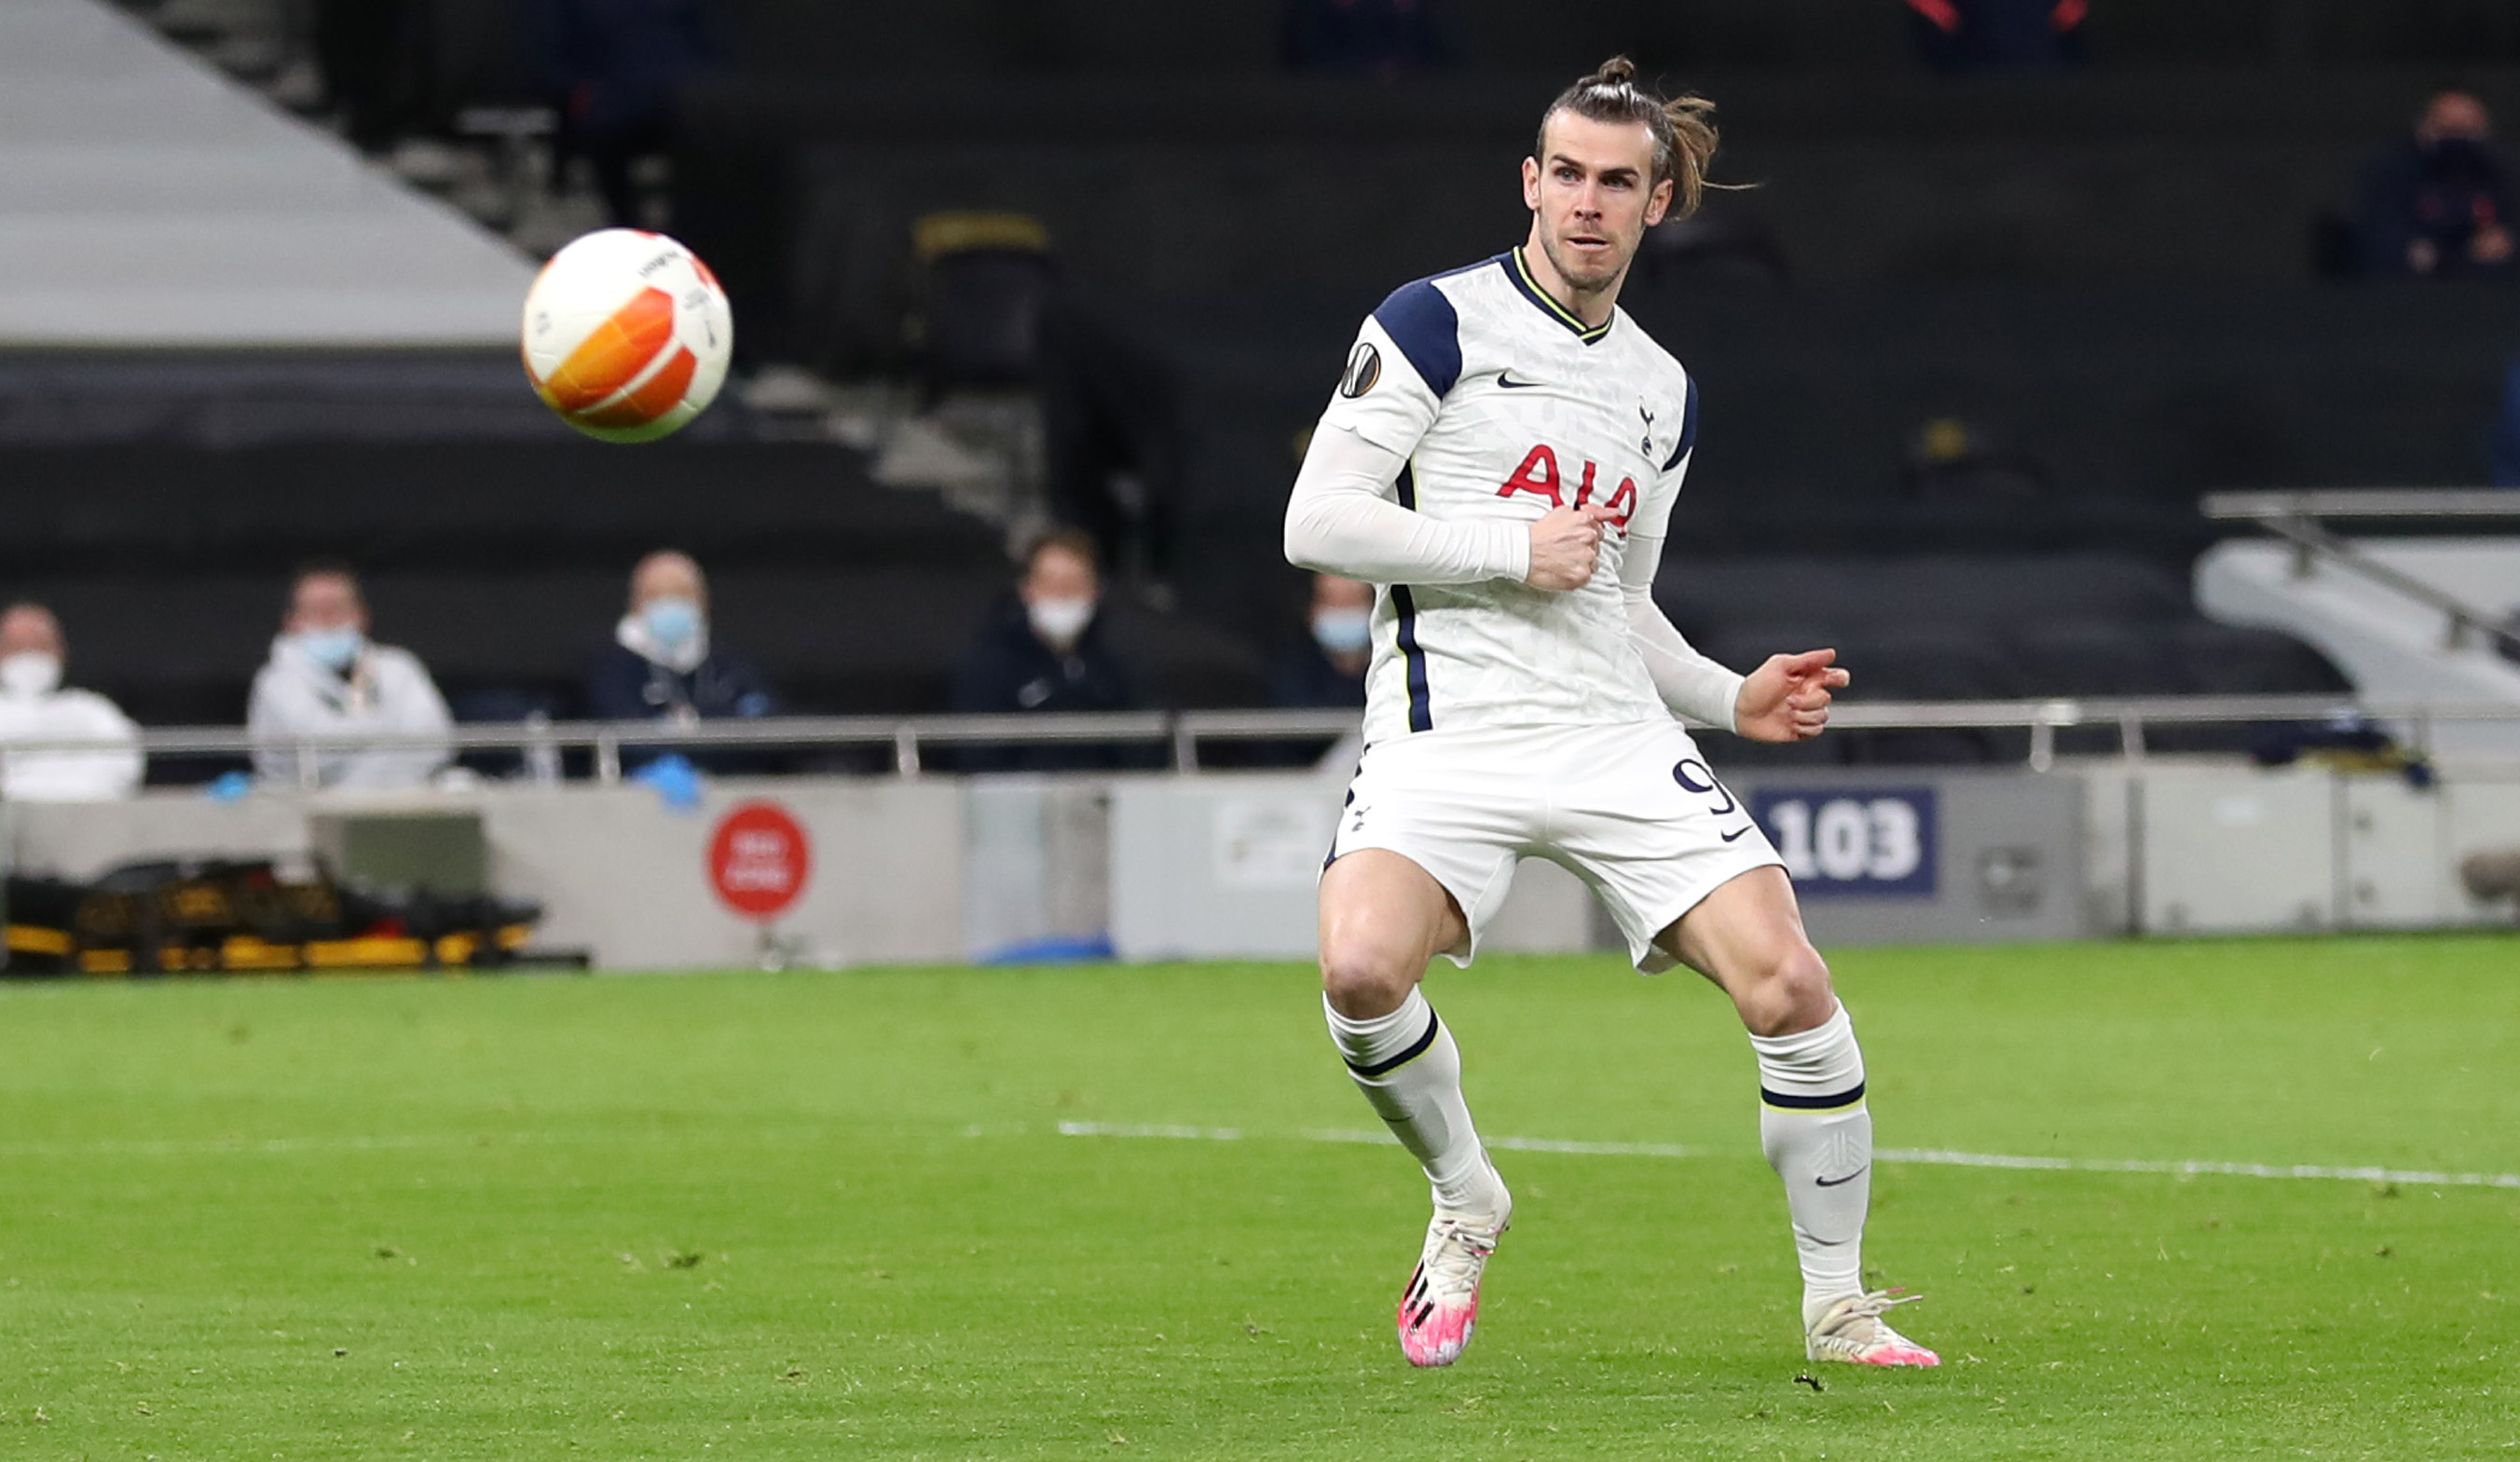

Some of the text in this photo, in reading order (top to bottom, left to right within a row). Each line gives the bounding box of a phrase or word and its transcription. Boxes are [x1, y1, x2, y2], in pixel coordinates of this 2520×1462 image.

[1496, 444, 1637, 538] AIA
[1672, 758, 1735, 815] 9
[1770, 798, 1922, 881] 103
